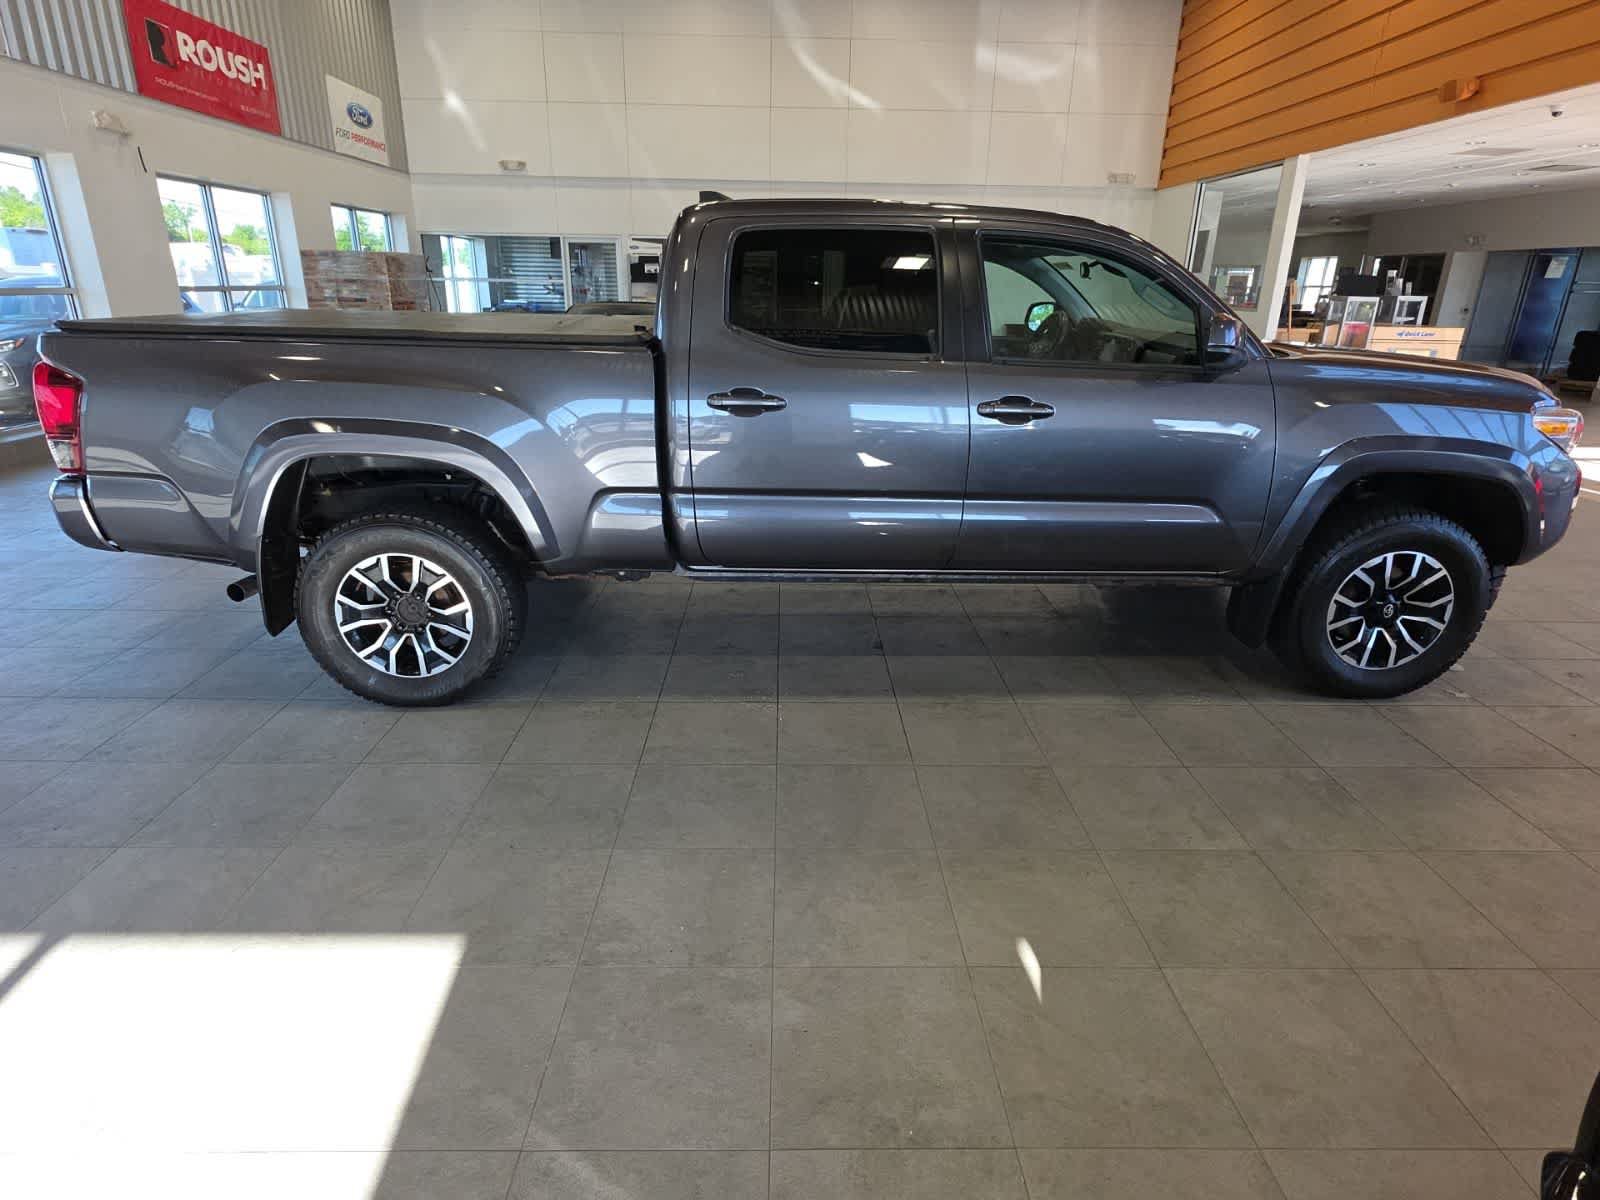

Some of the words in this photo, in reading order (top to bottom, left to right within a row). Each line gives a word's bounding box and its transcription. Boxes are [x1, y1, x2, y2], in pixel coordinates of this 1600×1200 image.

[176, 30, 266, 89] ROUSH
[350, 103, 369, 126] Ford
[336, 127, 351, 140] FORD
[351, 132, 386, 152] PERFORMANCE
